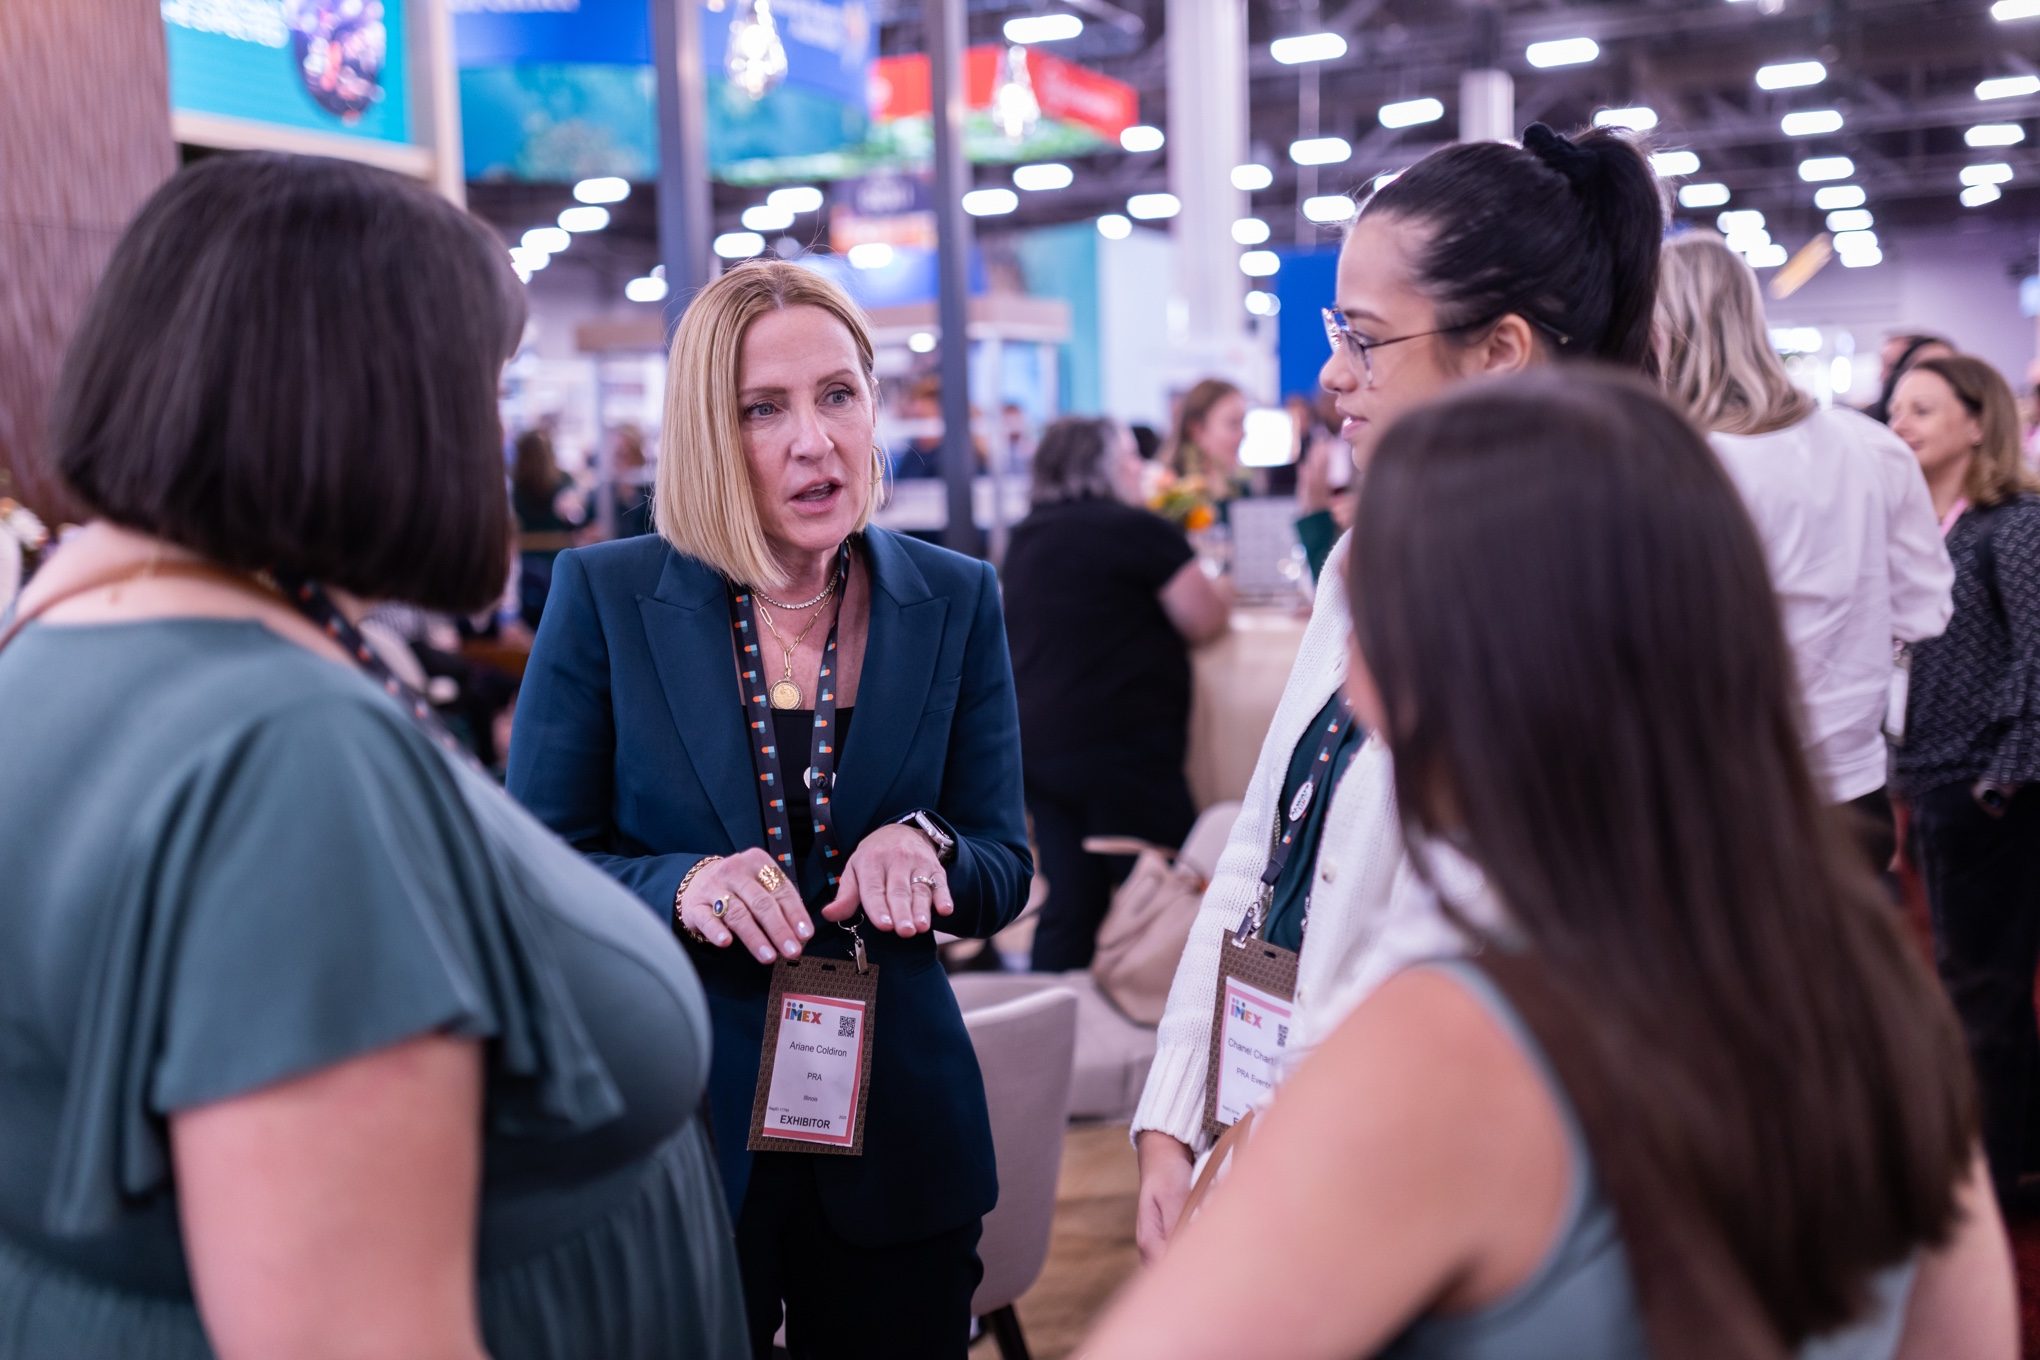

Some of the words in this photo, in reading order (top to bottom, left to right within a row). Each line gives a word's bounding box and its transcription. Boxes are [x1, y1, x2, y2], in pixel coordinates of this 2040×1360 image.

[784, 1001, 823, 1025] IMEX
[1230, 997, 1263, 1029] IMEX
[789, 1040, 815, 1053] Ariane
[816, 1044, 848, 1057] Coldiron
[1228, 1037, 1253, 1056] Chanel
[807, 1072, 823, 1082] PRA
[1236, 1067, 1250, 1080] PRA
[779, 1114, 831, 1129] EXHIBITOR
